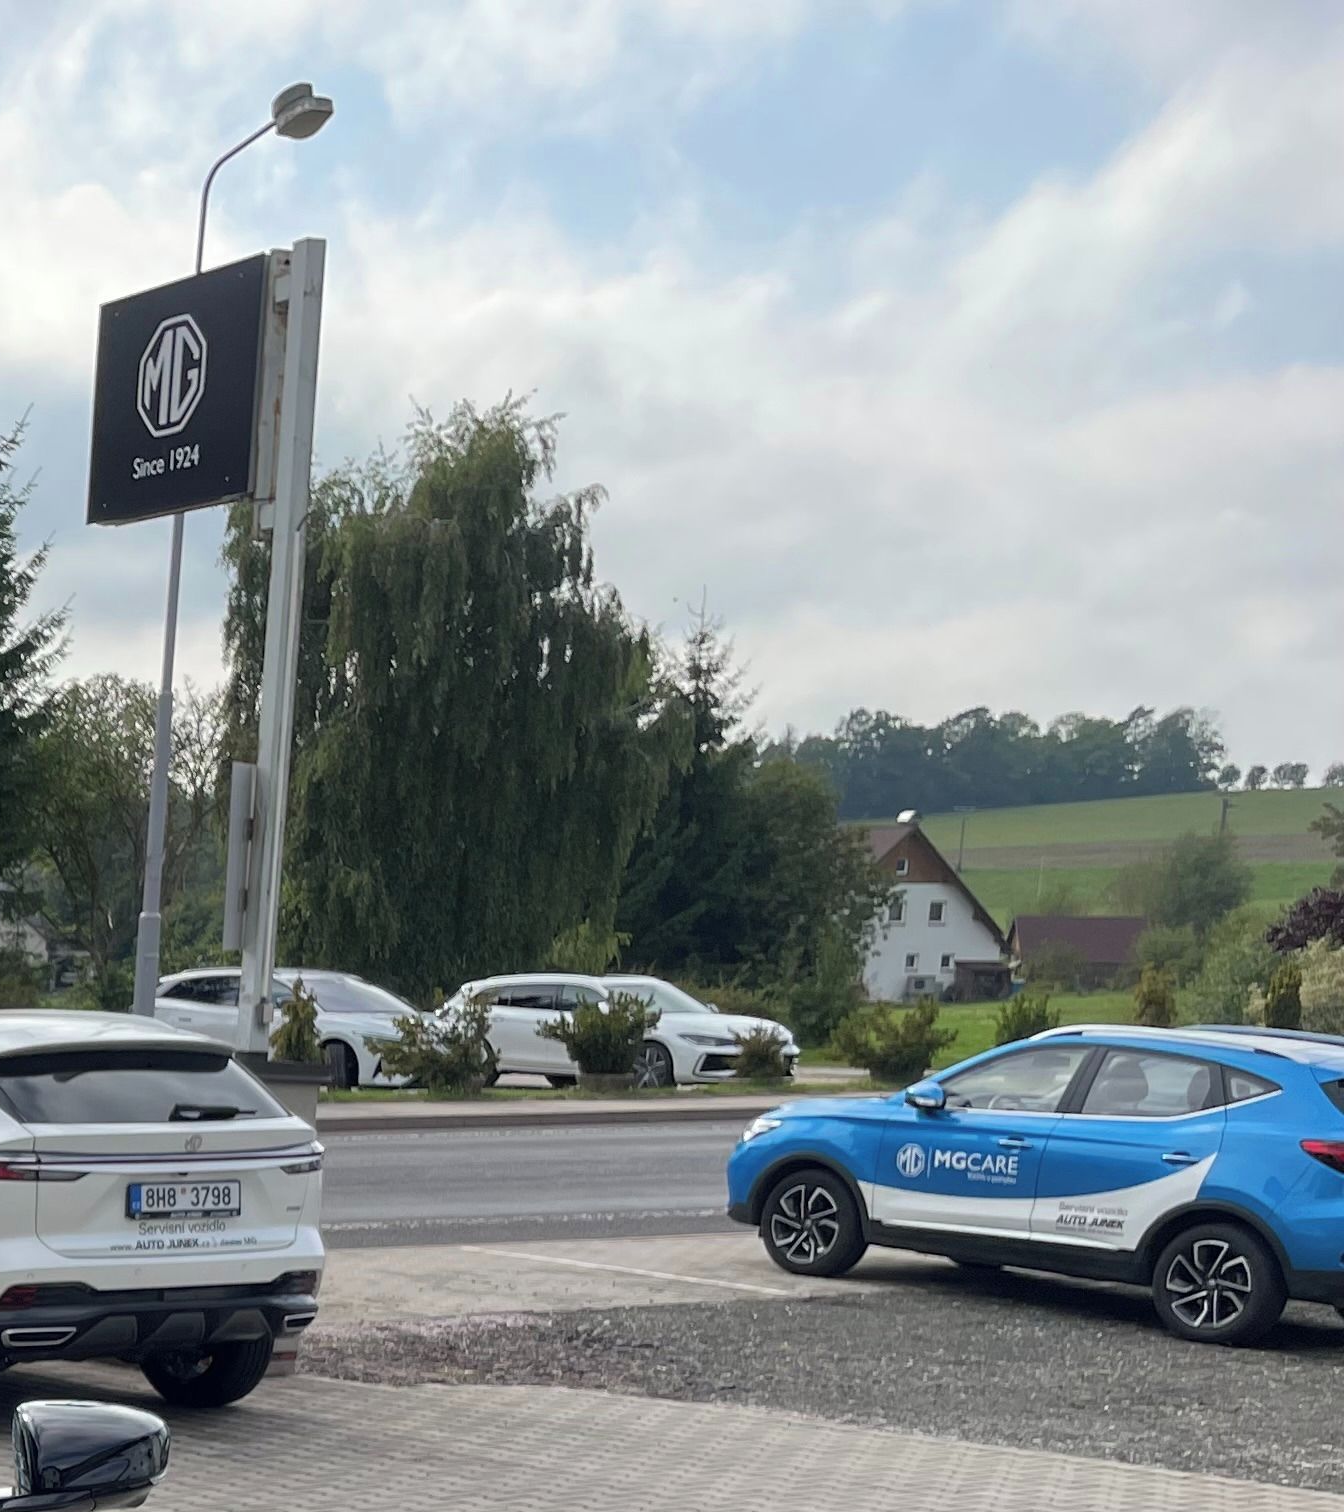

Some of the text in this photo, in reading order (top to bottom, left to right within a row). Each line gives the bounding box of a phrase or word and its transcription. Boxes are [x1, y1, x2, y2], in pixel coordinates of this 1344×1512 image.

[142, 325, 201, 427] MG
[132, 444, 200, 480] Since 1924
[145, 1187, 177, 1208] 8H8
[190, 1186, 231, 1206] 3798
[188, 1221, 226, 1234] vozidlo
